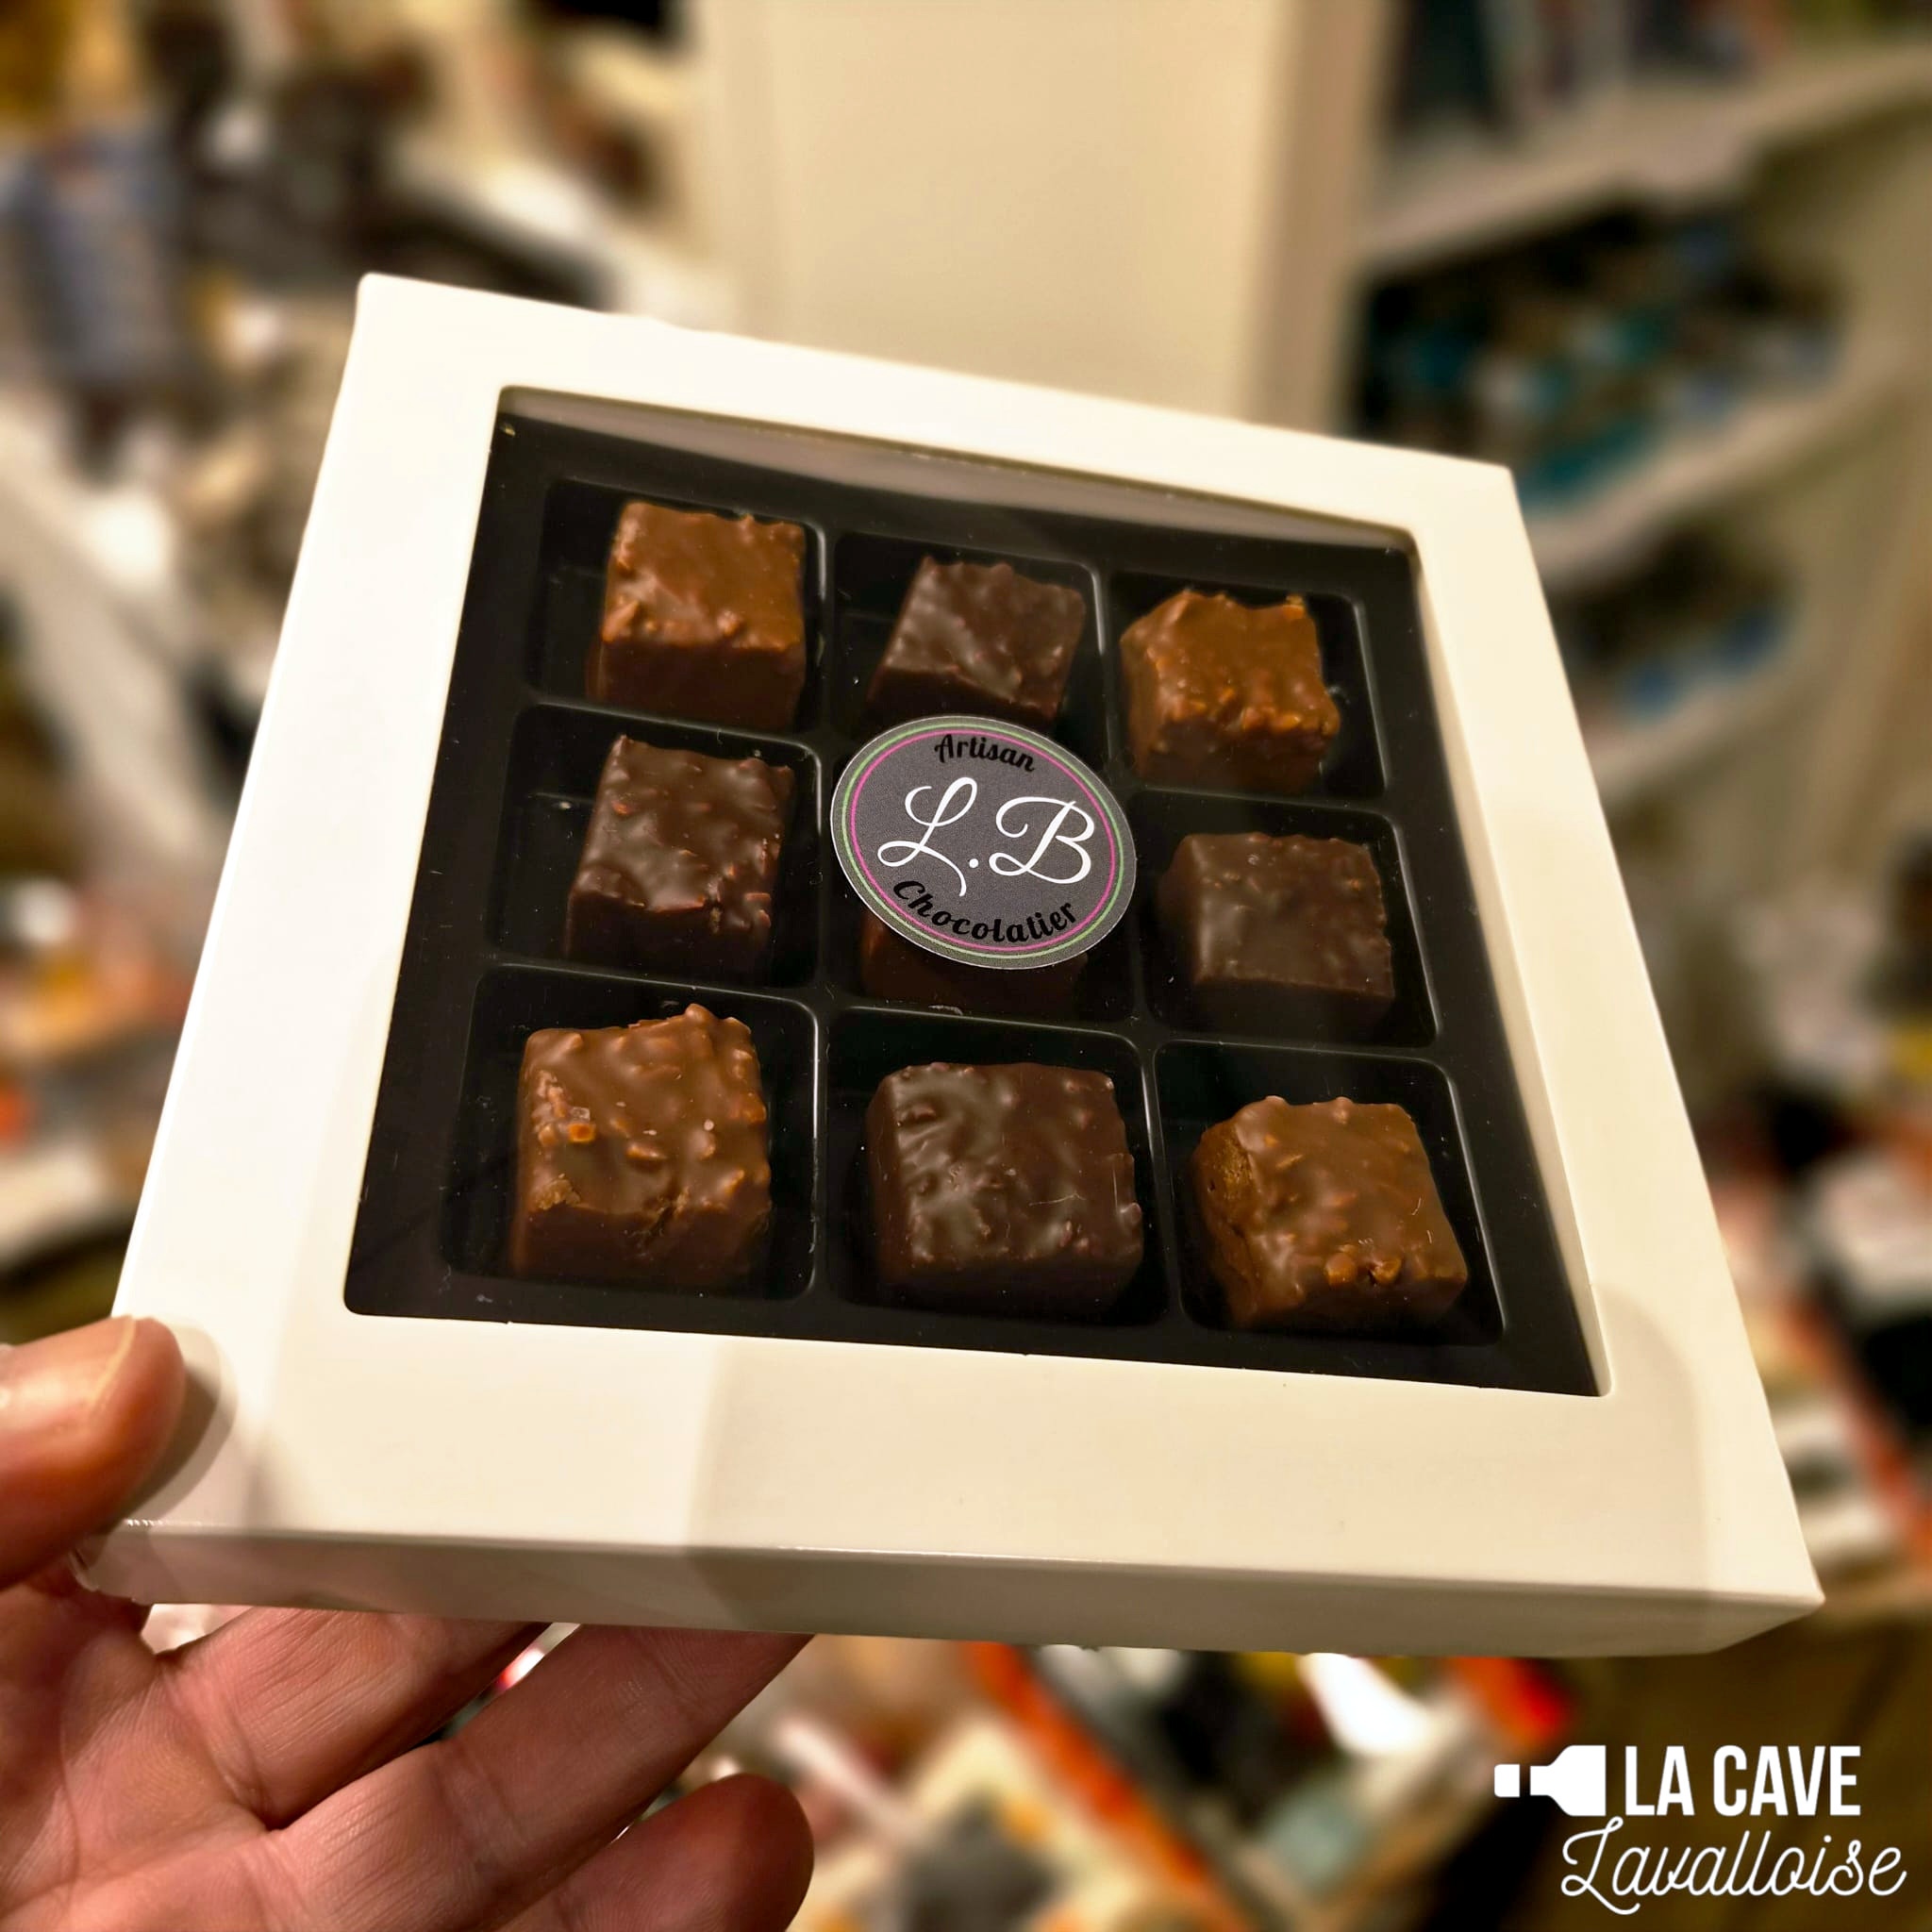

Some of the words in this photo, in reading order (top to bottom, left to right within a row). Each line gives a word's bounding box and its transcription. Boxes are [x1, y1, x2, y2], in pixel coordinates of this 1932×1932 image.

[934, 734, 1035, 773] Artisan
[877, 776, 1094, 897] L.B
[892, 879, 1077, 943] Chocolatier
